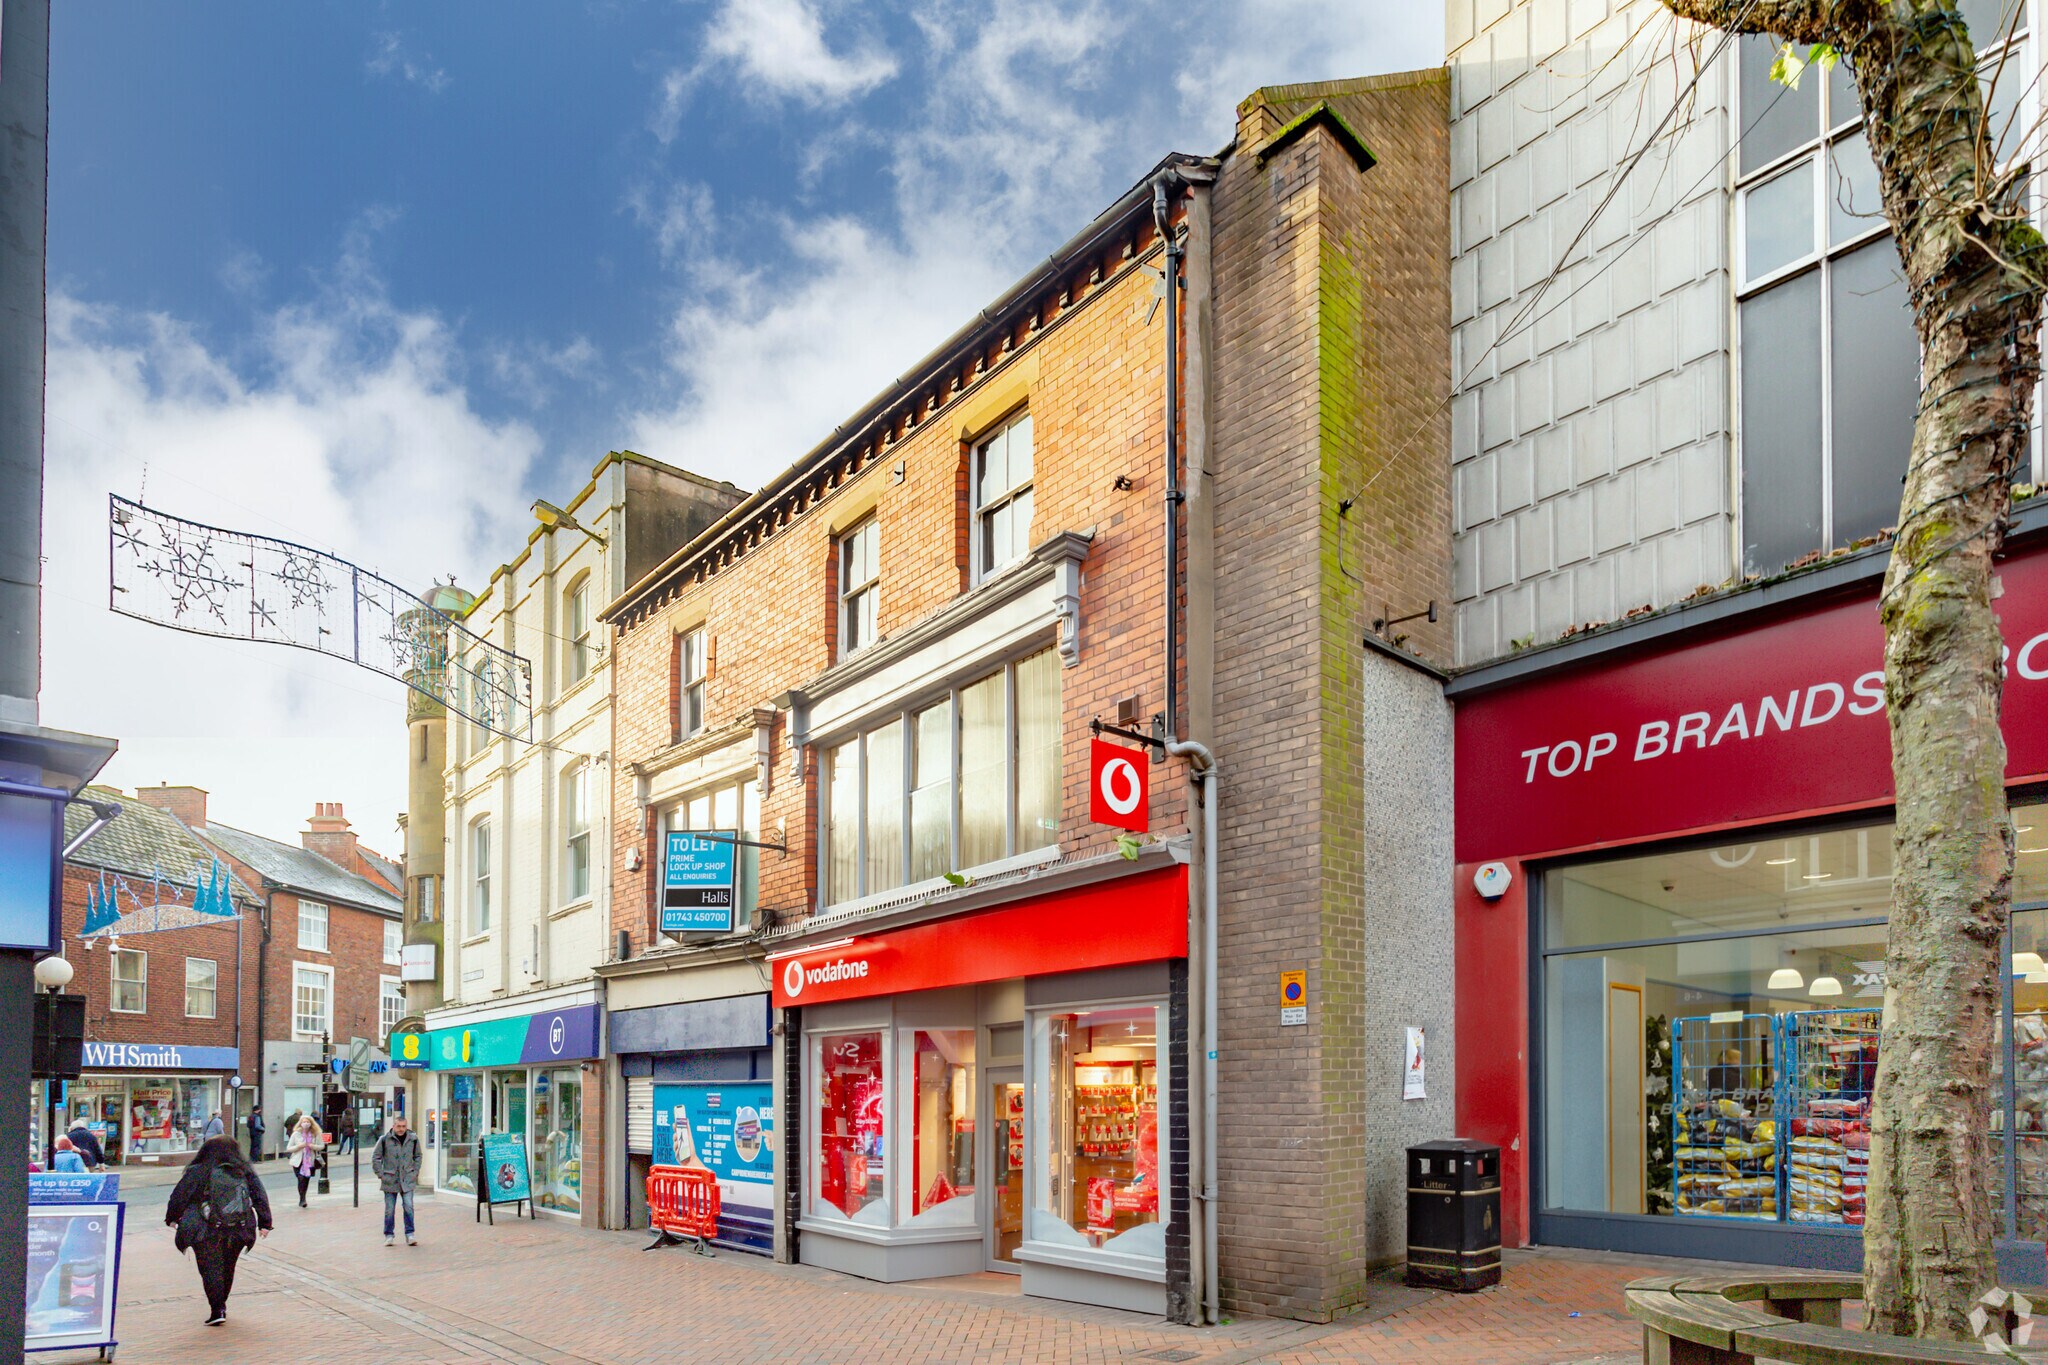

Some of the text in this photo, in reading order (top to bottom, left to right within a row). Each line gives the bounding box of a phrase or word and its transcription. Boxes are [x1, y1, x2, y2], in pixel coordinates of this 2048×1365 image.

[1520, 731, 1617, 784] TOP
[1633, 670, 1886, 763] BRANDS
[672, 838, 716, 852] TO LET
[670, 854, 695, 862] PRIME
[670, 863, 690, 871] LOCK
[704, 862, 726, 870] SHOP
[702, 891, 729, 904] Halls
[666, 912, 726, 922] 01743 450700
[806, 958, 868, 985] vodafone
[552, 1028, 562, 1043] BT
[84, 1043, 182, 1067] WHSmith
[352, 1081, 366, 1089] ENDS
[1682, 1088, 1722, 1100] TOP
[1423, 1180, 1447, 1189] Litter
